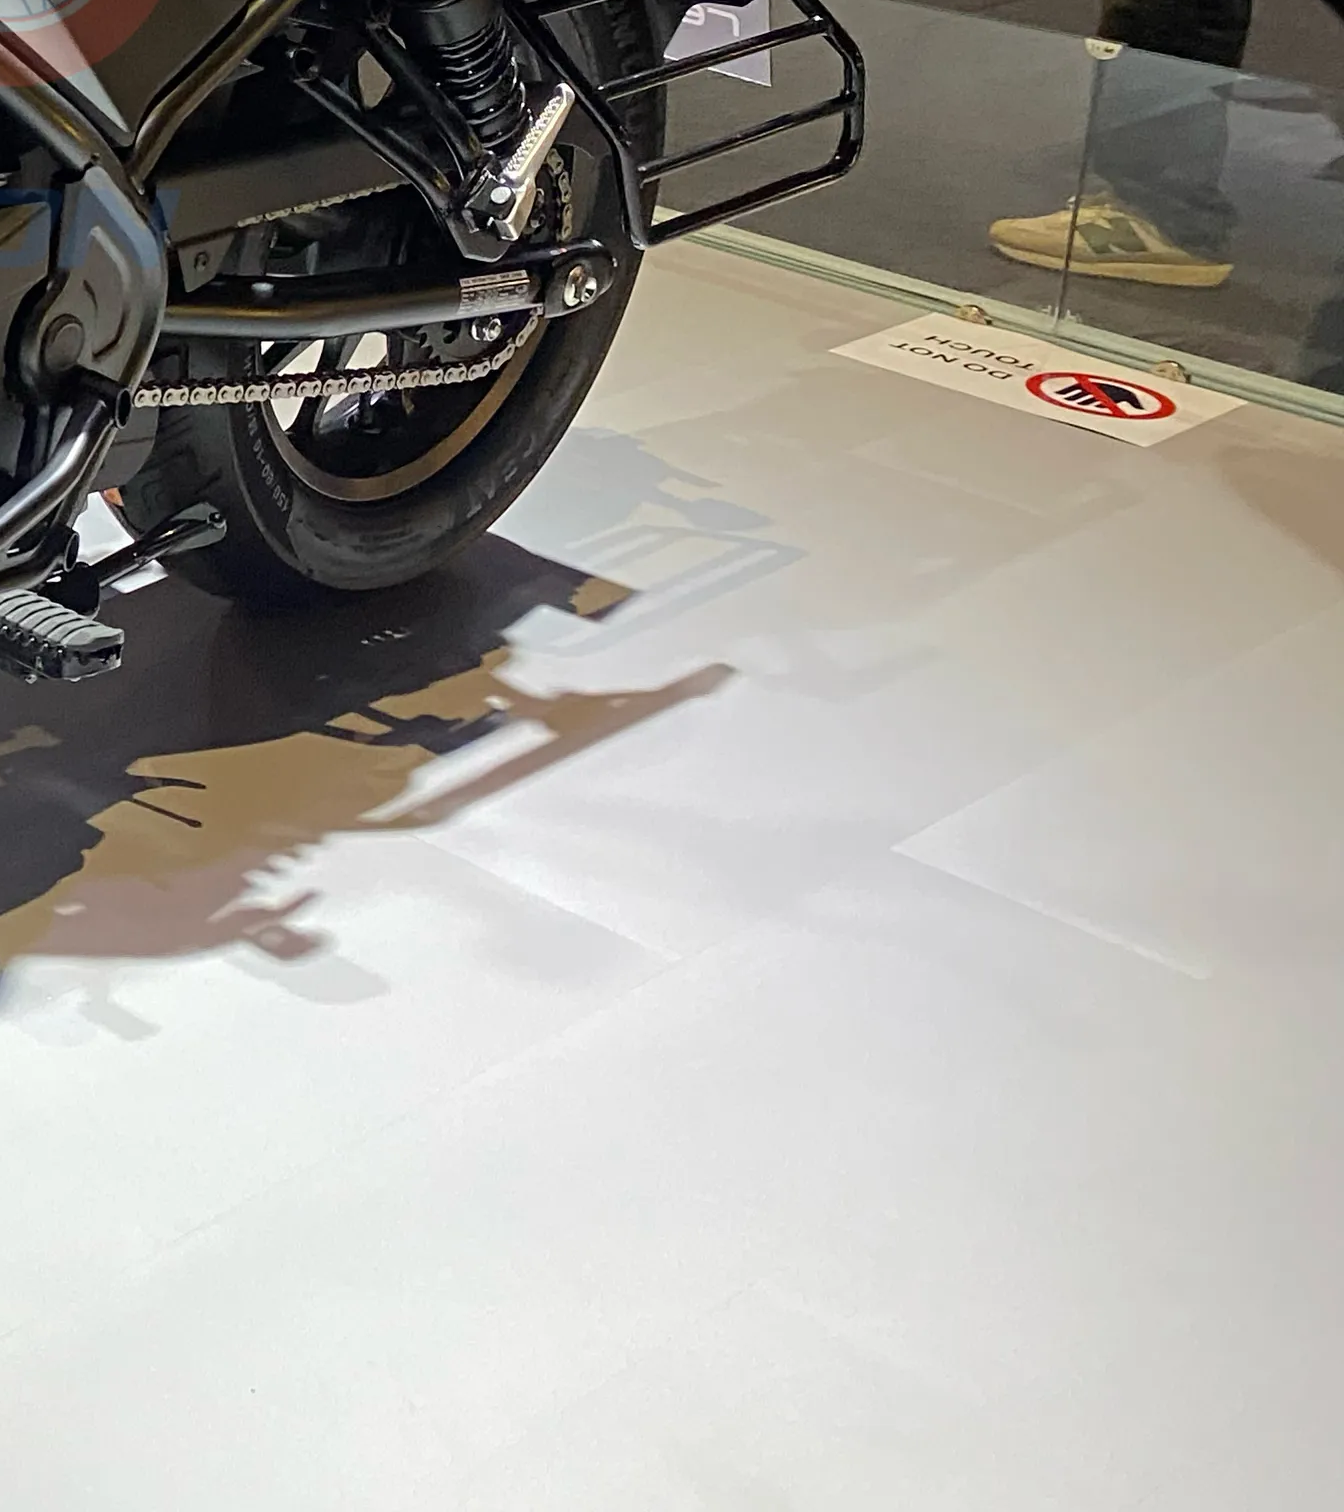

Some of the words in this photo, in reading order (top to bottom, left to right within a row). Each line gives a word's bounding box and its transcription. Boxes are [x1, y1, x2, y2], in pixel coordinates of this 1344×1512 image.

[890, 342, 959, 364] NOT
[925, 335, 1035, 370] TOUCH
[963, 363, 1013, 379] DO
